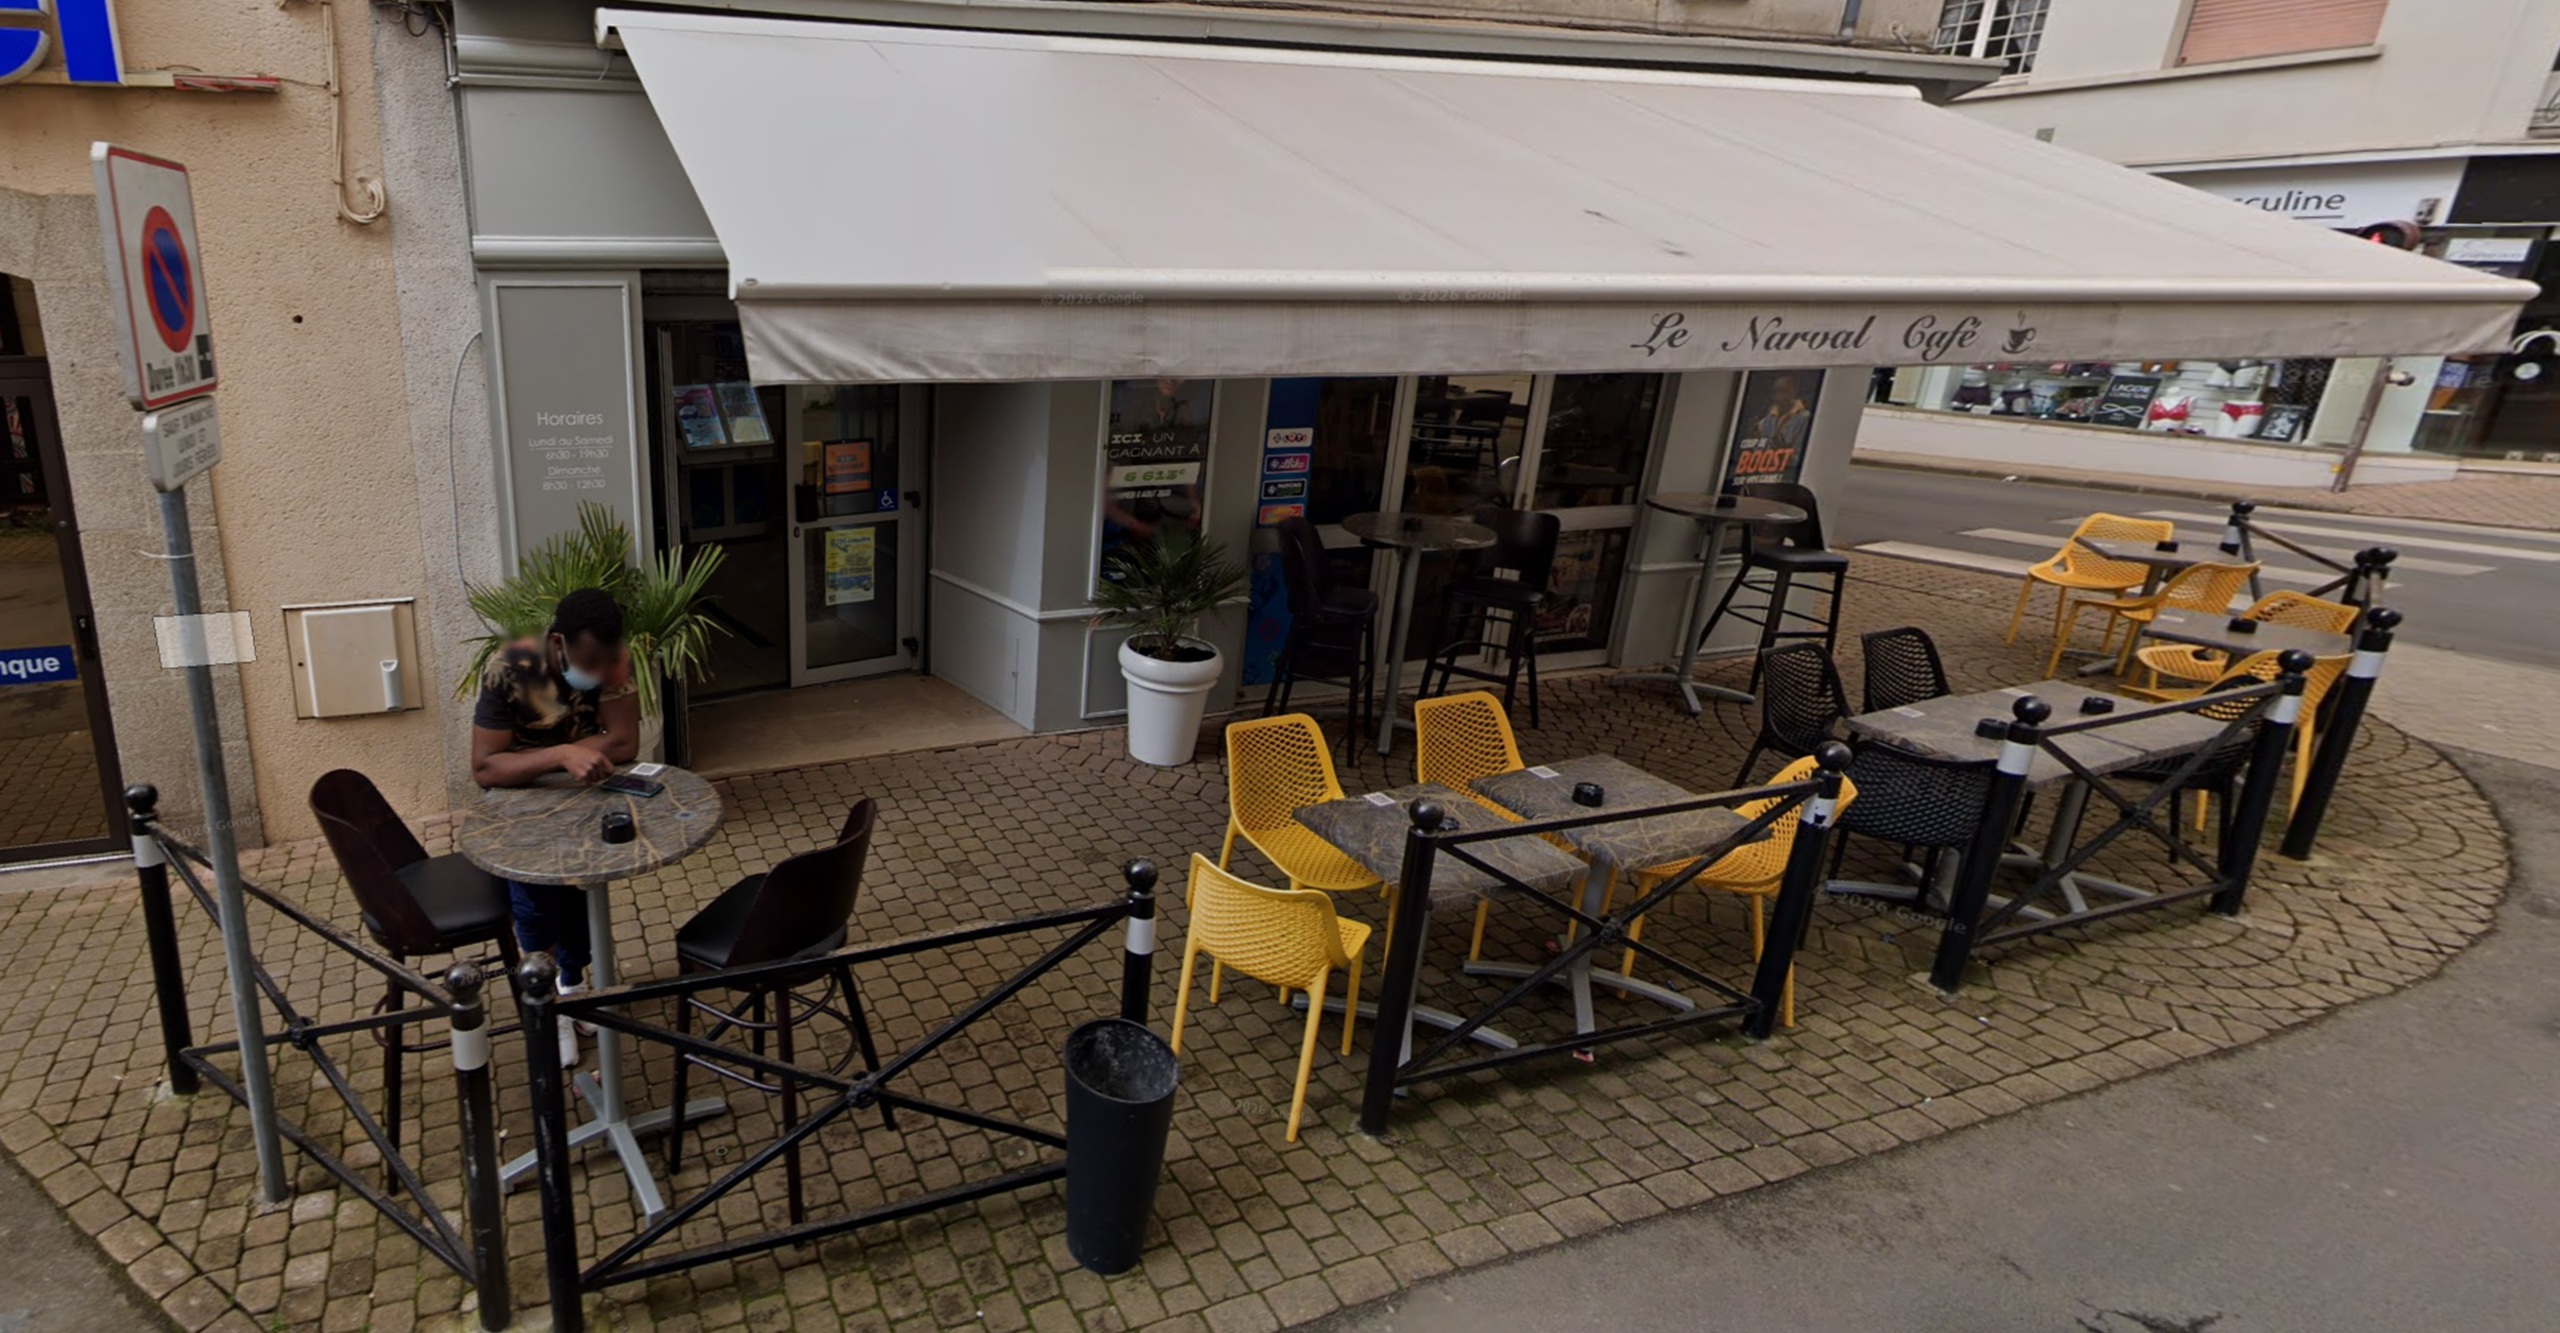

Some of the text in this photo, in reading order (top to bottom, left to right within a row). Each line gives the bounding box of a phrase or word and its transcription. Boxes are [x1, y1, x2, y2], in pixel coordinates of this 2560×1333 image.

[1631, 312, 1983, 362] Le Narval Café
[536, 410, 604, 426] Horaires
[528, 434, 614, 448] Lundi au Samedi
[1152, 431, 1176, 443] UN
[545, 449, 571, 460] 6h30
[579, 448, 609, 459] 19h30
[1108, 445, 1185, 459] GAGNANT
[1735, 448, 1796, 475] BOOST
[548, 464, 602, 476] Dimanche
[542, 480, 568, 491] 8h30
[576, 478, 606, 490] 12h30
